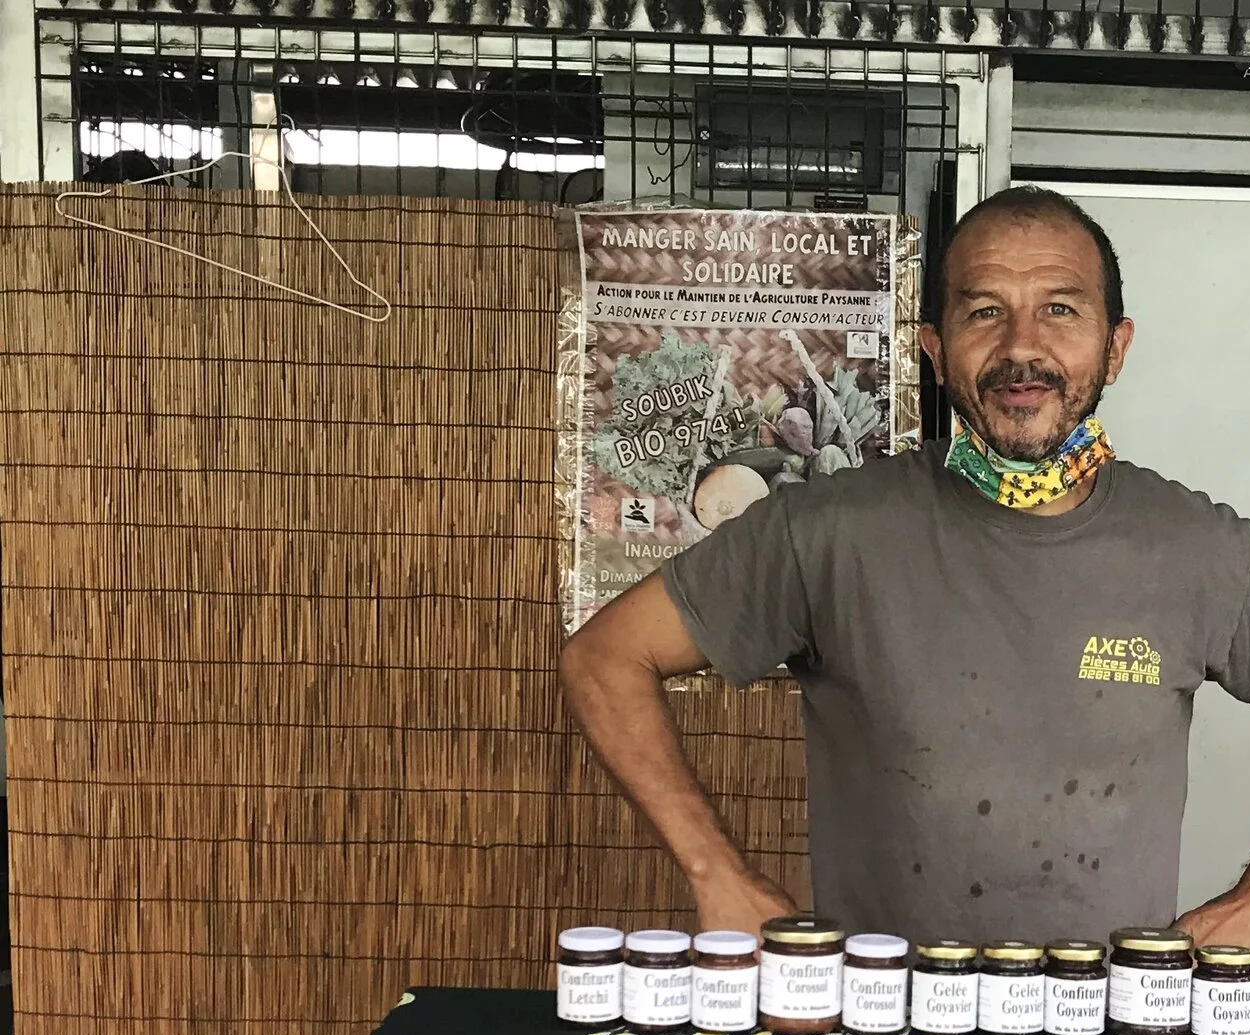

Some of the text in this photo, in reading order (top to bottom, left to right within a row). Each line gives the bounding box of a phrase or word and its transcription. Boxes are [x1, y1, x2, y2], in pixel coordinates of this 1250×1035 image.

[602, 228, 872, 256] MANGER SAIN, LOCAL ET
[682, 261, 794, 285] SOLIDAIRE
[597, 284, 632, 299] ACTION
[635, 289, 661, 300] POUR
[663, 291, 674, 300] LE
[677, 289, 726, 303] MAINTIEN
[728, 293, 741, 303] DE
[744, 291, 819, 305] L'AGRICULTURE
[821, 293, 871, 306] PAYSANNE
[594, 301, 885, 325] S'ABONNER C'EST DEVENIR CONSOM'ACTEUR
[621, 374, 714, 422] SOUBIK
[614, 429, 666, 468] BIO
[674, 415, 729, 447] 974
[625, 541, 689, 559] INAUGU
[600, 569, 649, 583] DIMAN
[1083, 636, 1128, 657] AXE
[1080, 655, 1160, 674] Pièces Auto
[1079, 668, 1111, 681] 0262
[779, 962, 834, 978] Confiture
[695, 976, 748, 994] Confiture
[850, 978, 902, 995] Confiture
[933, 981, 968, 997] Gelée
[1009, 983, 1040, 999] Gelée
[1140, 974, 1190, 990] Confiture
[1053, 984, 1104, 1000] Confiture
[927, 998, 972, 1017] Goyavier
[1056, 1001, 1099, 1021] Goyavier
[1145, 992, 1186, 1012] Goyavier
